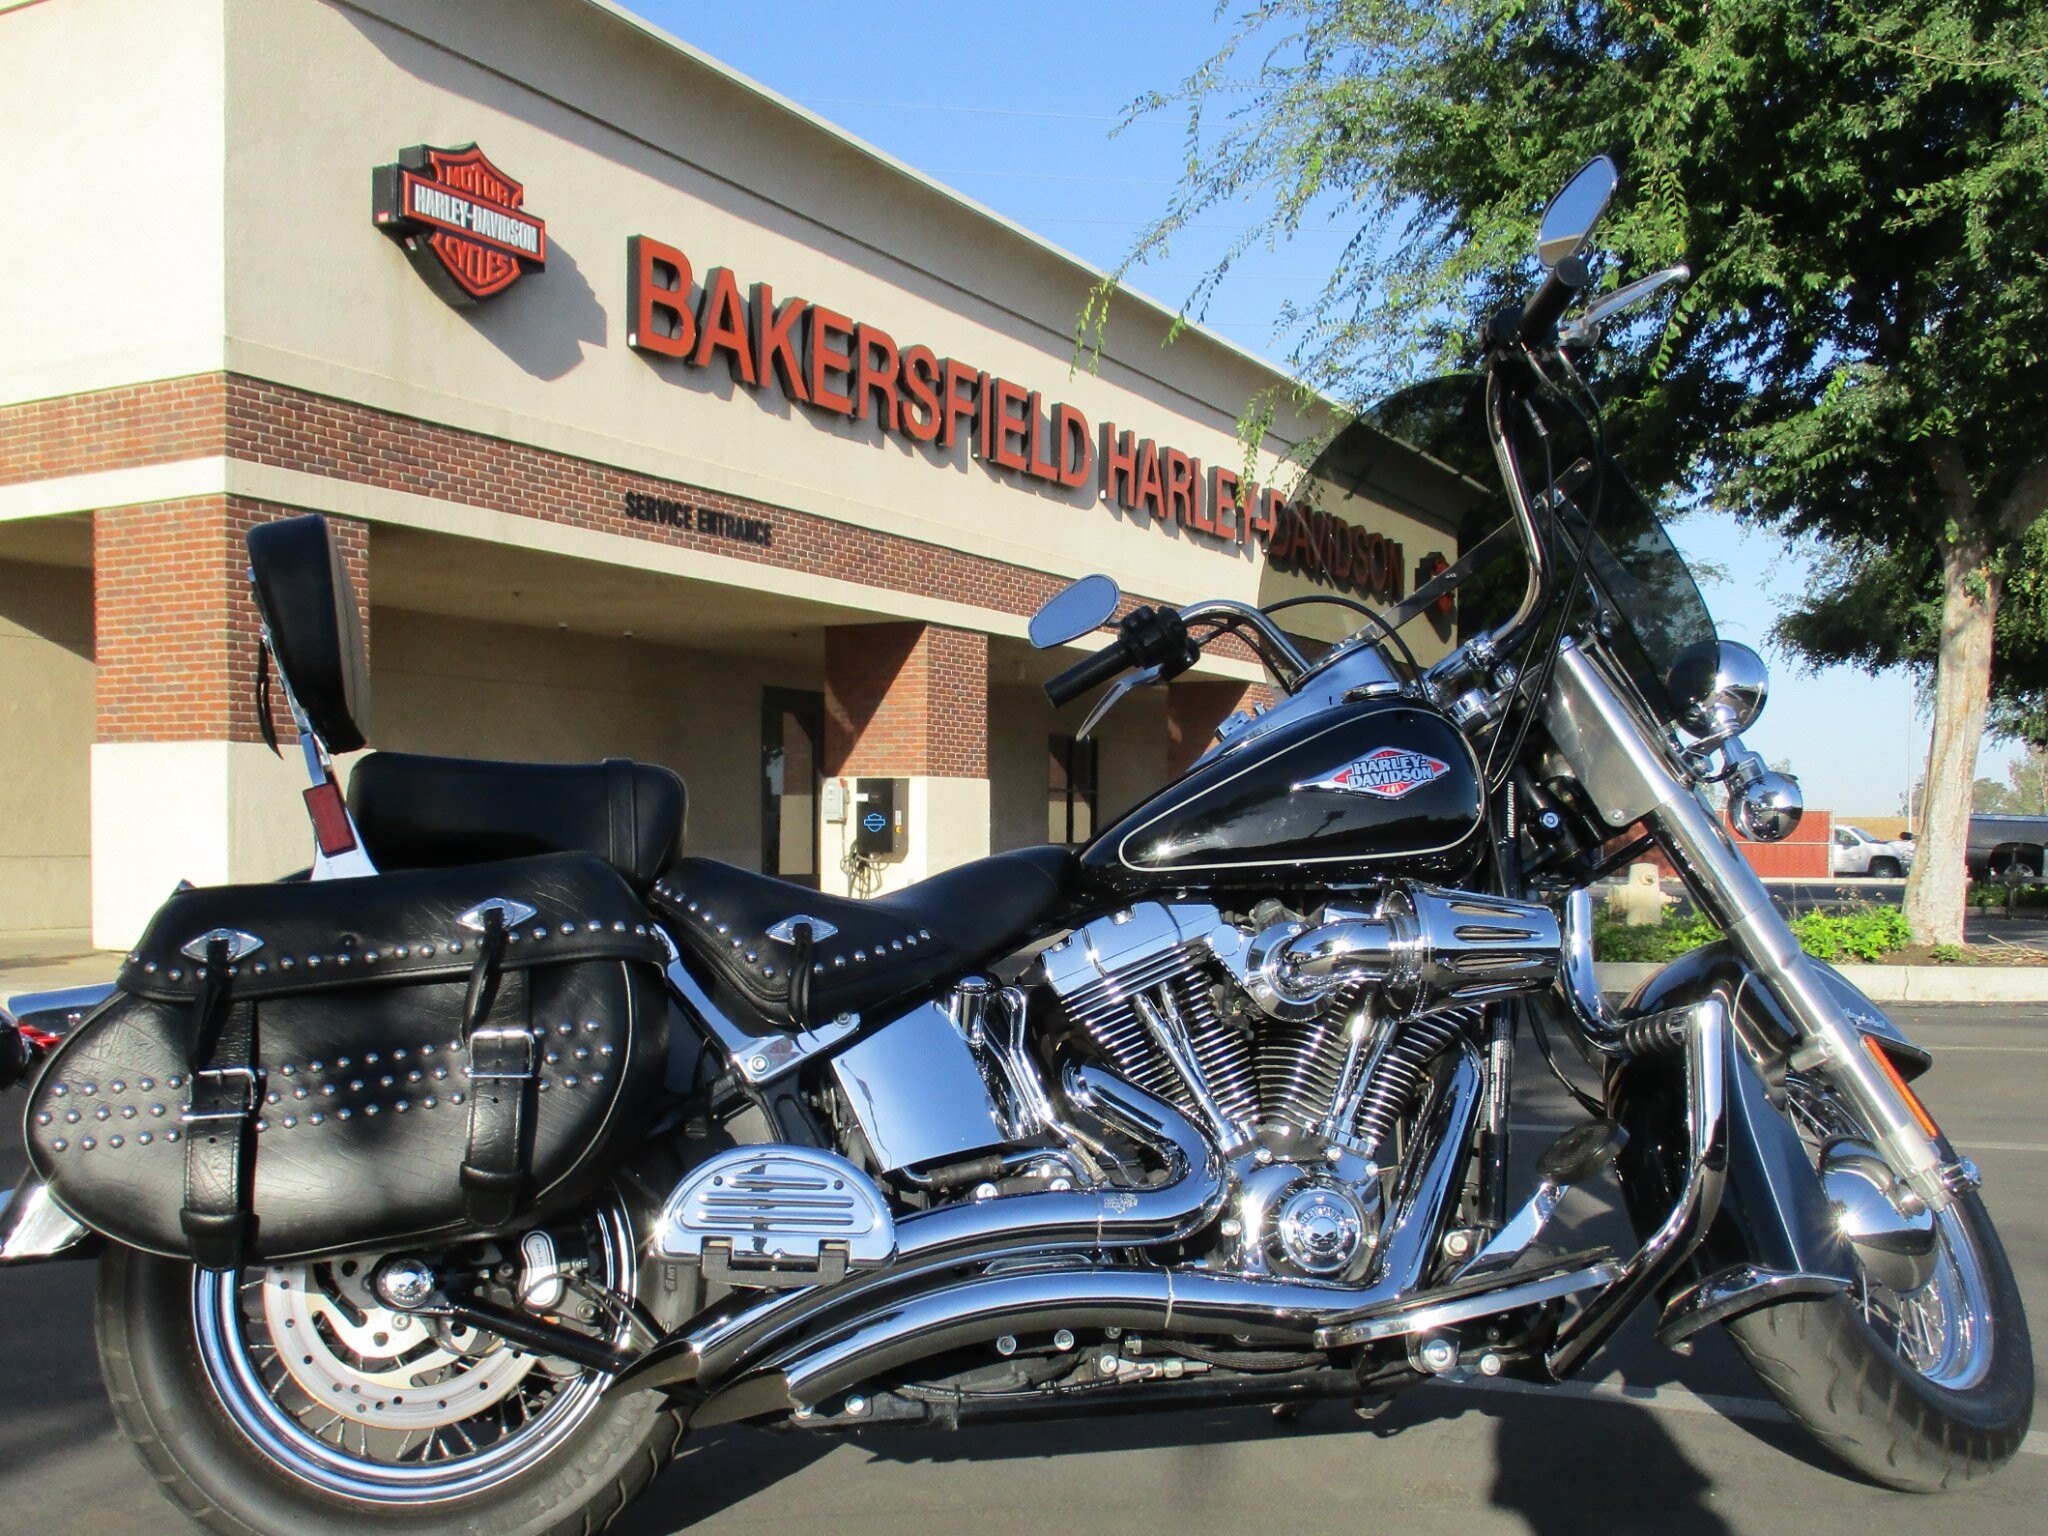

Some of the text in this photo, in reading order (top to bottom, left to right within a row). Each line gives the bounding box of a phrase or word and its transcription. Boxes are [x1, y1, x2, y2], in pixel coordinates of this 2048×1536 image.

[446, 162, 510, 207] MOTOR
[414, 182, 539, 254] HARLEY-DAVIDSON
[445, 234, 509, 286] CYCLES
[627, 234, 1404, 604] BAKERSFIELD HARLEY-DAVIDSON
[625, 491, 772, 548] SERVICE ENTRANCE
[1348, 765, 1434, 789] DAVIDSON
